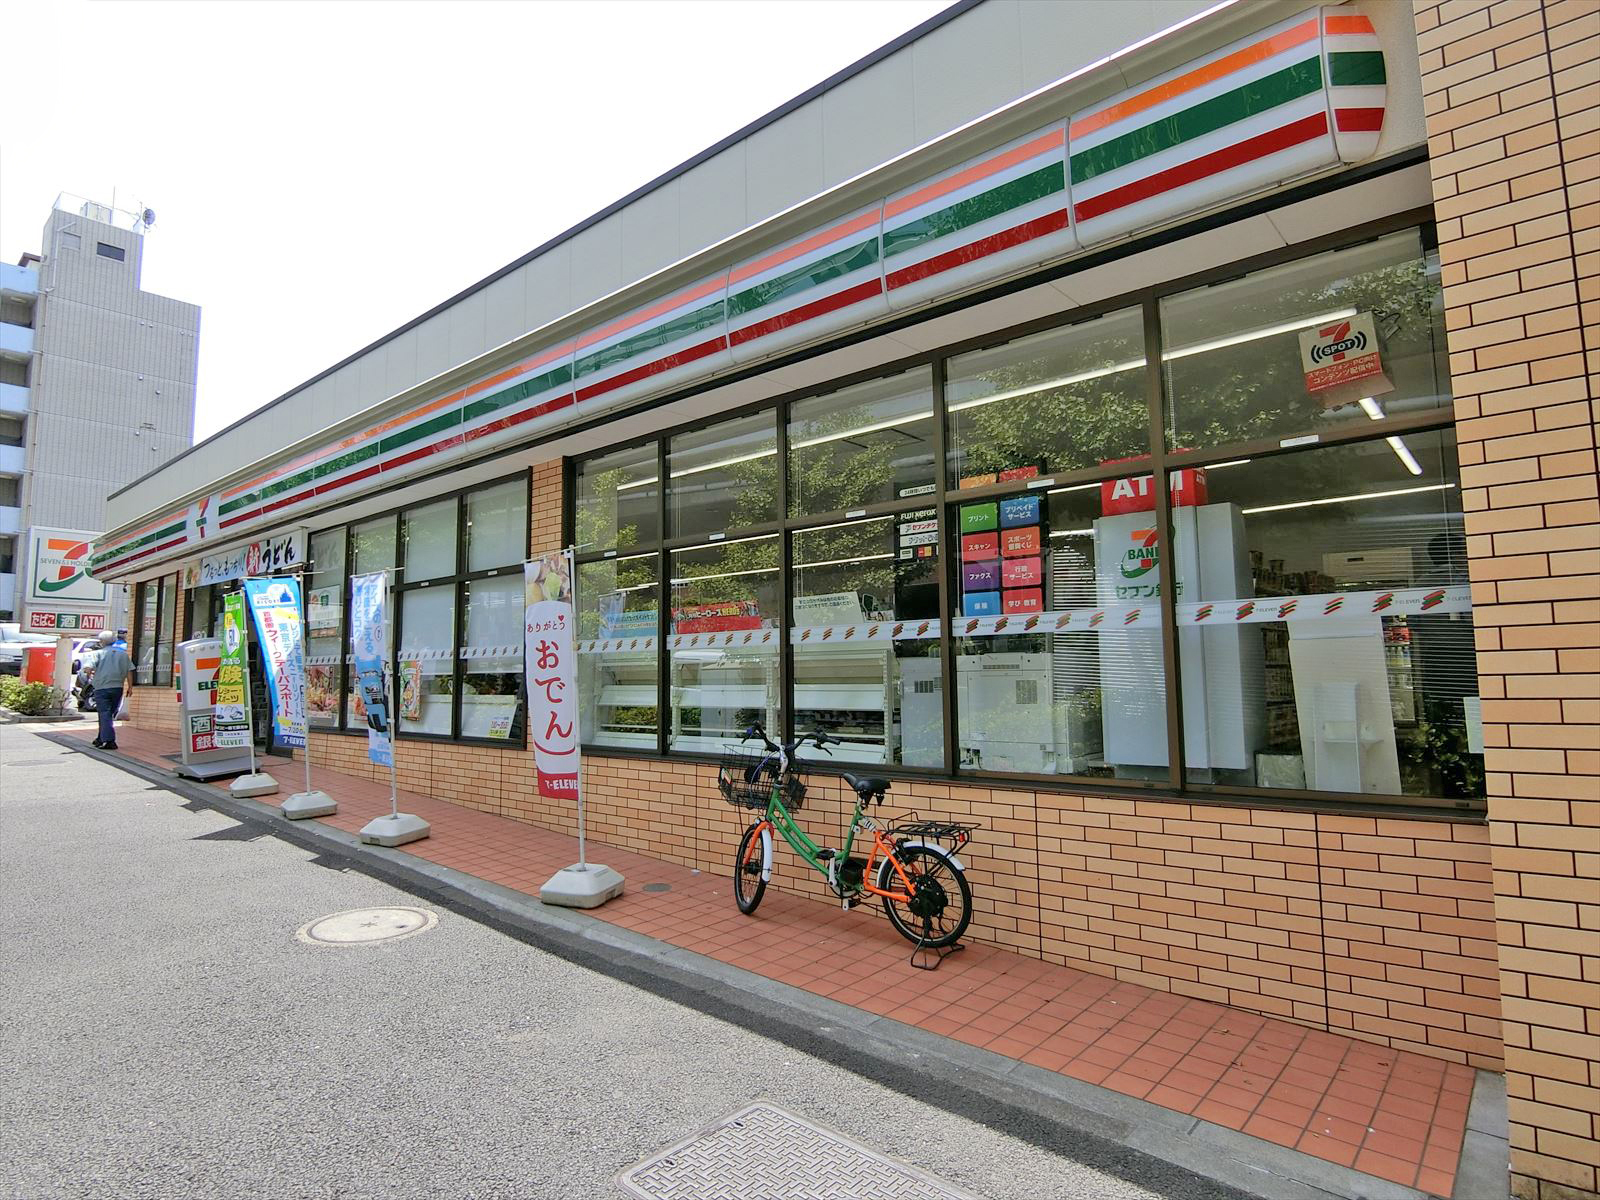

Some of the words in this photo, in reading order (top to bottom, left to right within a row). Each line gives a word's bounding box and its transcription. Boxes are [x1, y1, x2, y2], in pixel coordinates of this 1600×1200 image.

[1324, 340, 1352, 354] SPOT
[1005, 503, 1033, 513] プリペイド
[900, 512, 914, 520] FUJI
[968, 514, 989, 523] プリント
[1007, 511, 1031, 520] サービス
[1008, 534, 1032, 543] スポーツ
[968, 543, 991, 551] スキャン
[969, 572, 991, 580] ファクス
[1009, 572, 1034, 580] サービス
[32, 613, 55, 627] たばこ
[60, 615, 77, 627] 酒
[82, 616, 104, 628] ATM
[527, 622, 565, 633] ありがとう
[535, 639, 573, 740] おでん
[192, 717, 211, 732] 酒
